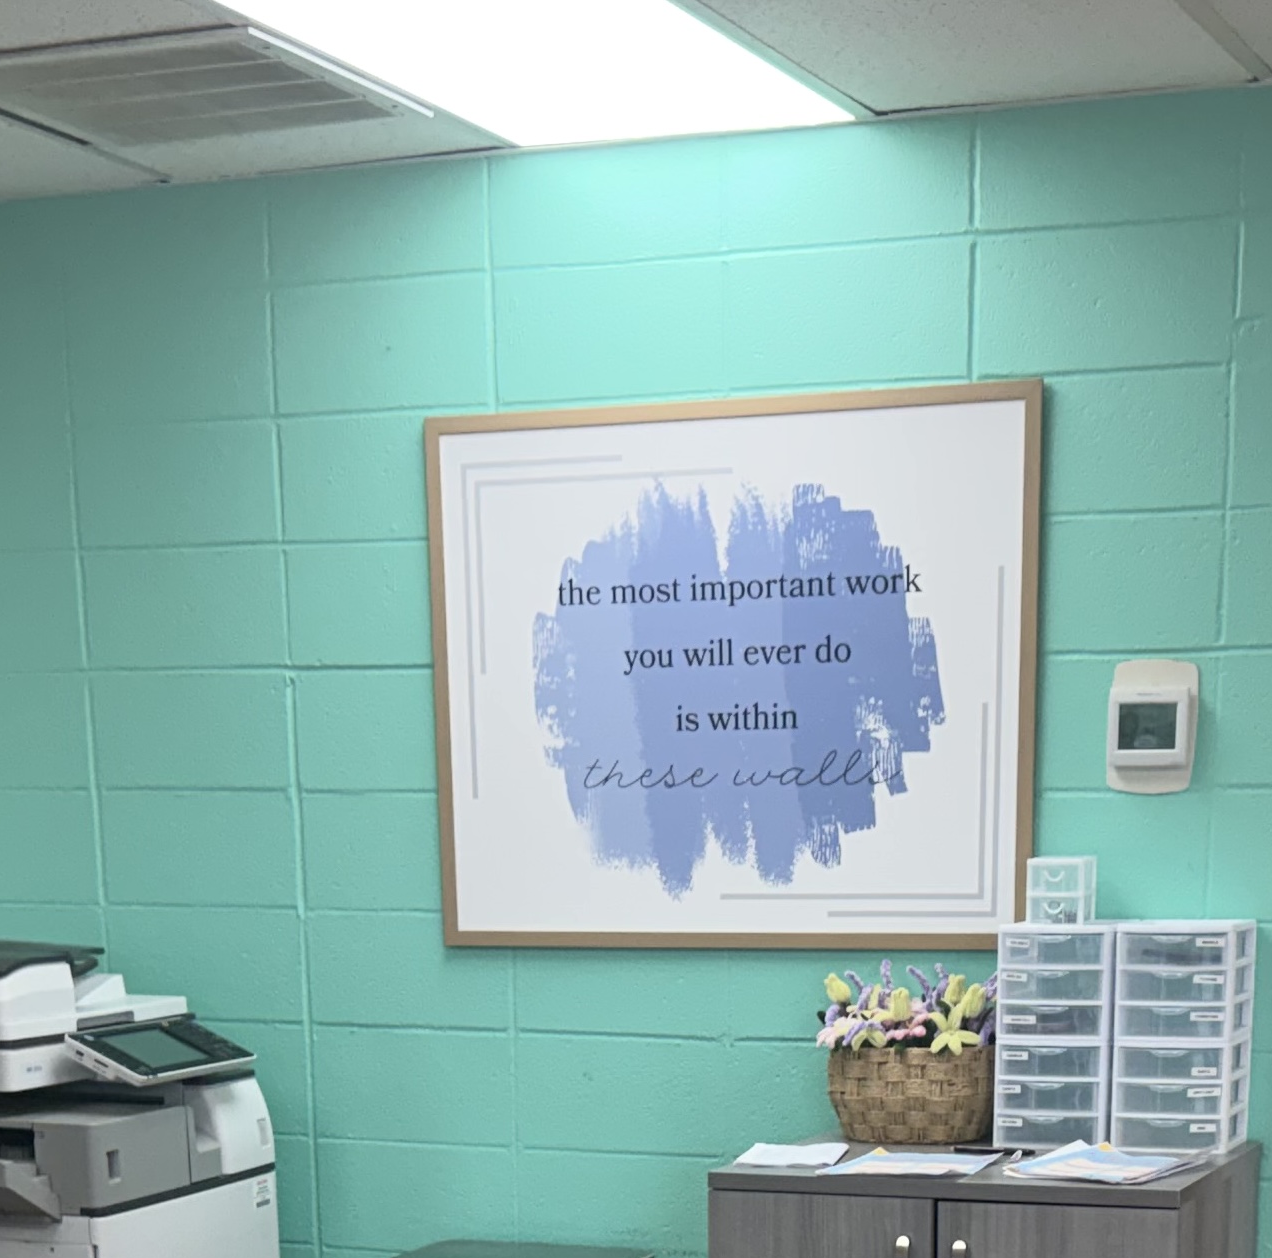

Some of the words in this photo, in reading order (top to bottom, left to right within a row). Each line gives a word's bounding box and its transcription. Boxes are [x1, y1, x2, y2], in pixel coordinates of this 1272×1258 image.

[558, 578, 602, 606] the
[611, 578, 681, 605] most
[690, 571, 836, 607] important
[845, 564, 922, 596] work
[623, 648, 674, 676] you
[683, 638, 734, 667] will
[743, 643, 806, 666] ever
[815, 634, 852, 664] do
[676, 705, 700, 732] is
[707, 702, 799, 731] within
[583, 757, 718, 790] these
[732, 748, 904, 788] walls
